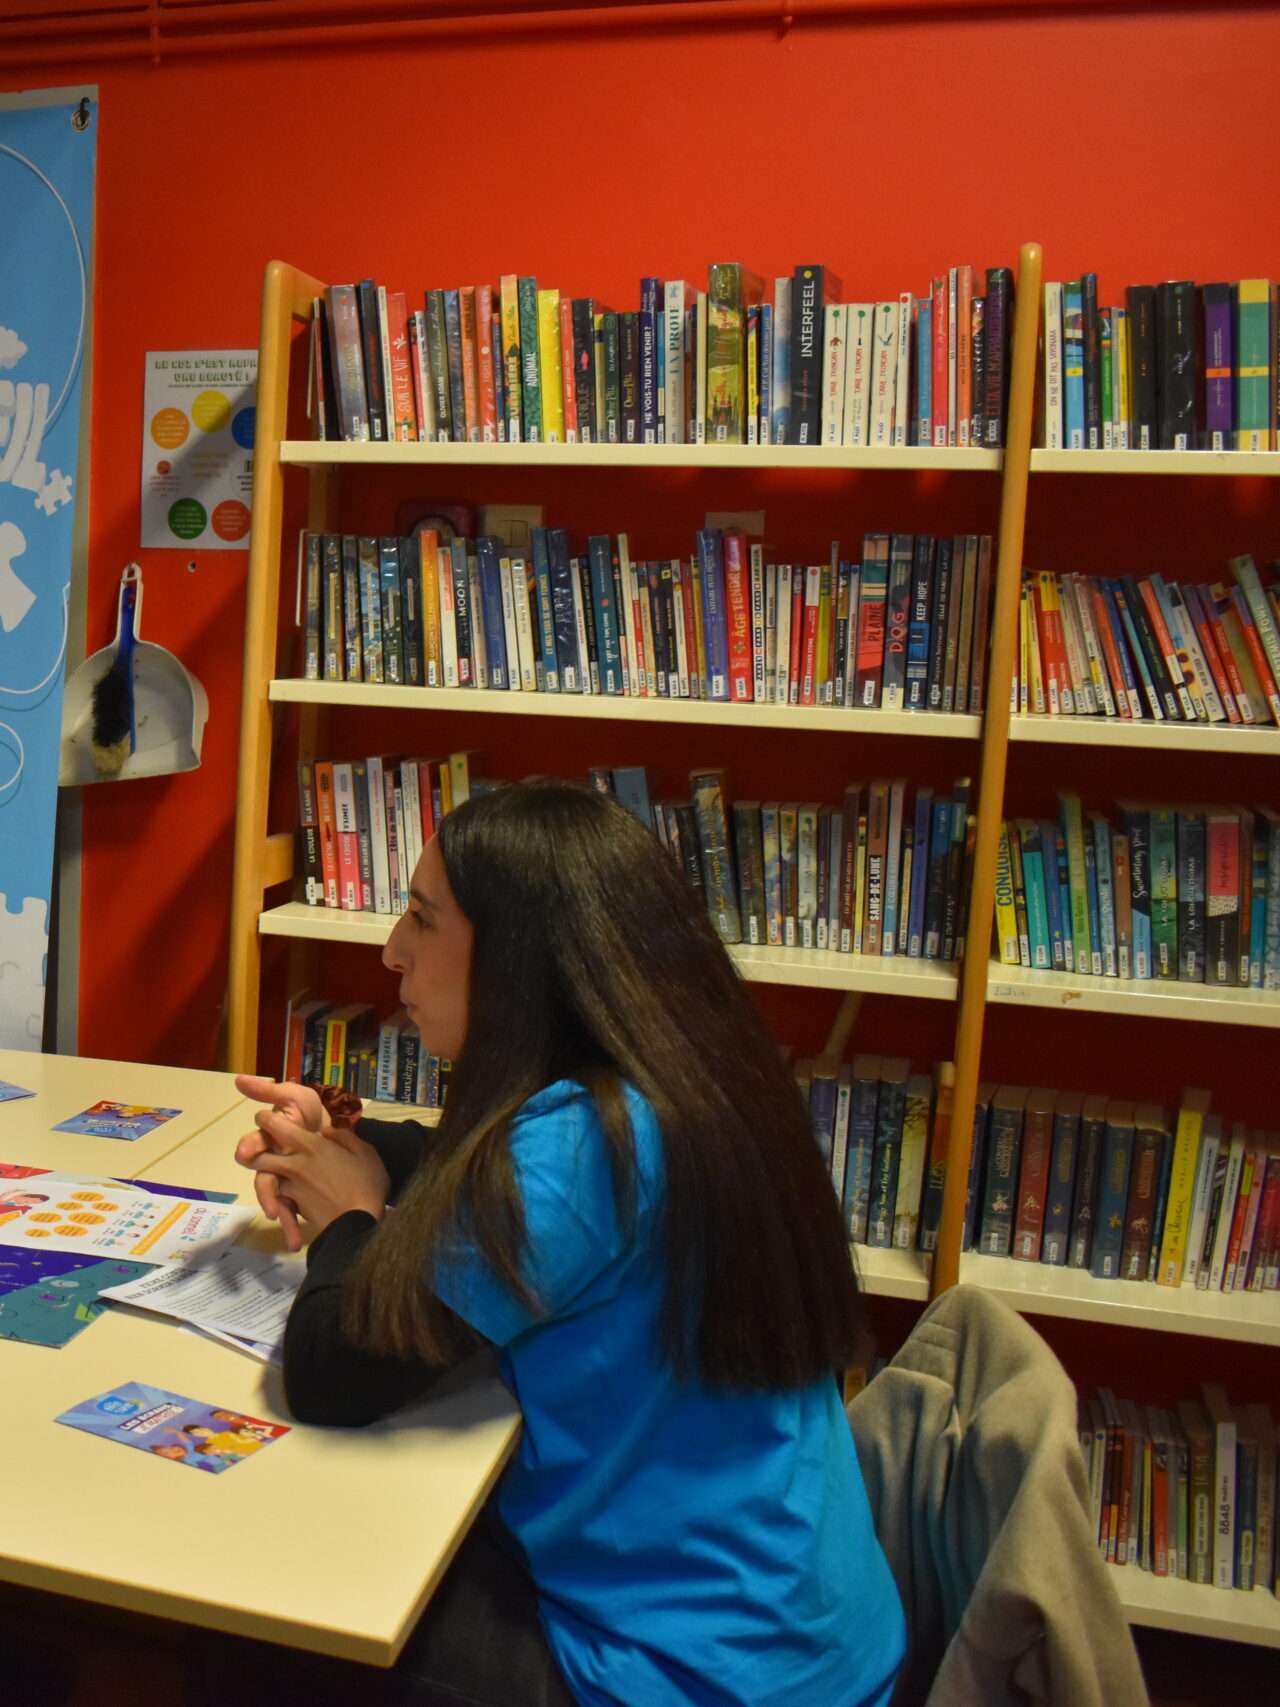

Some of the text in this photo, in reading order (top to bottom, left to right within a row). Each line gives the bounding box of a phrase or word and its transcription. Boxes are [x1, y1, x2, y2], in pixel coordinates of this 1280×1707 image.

[801, 281, 814, 357] INTERFEEL
[395, 375, 408, 388] LE
[396, 392, 410, 412] SUR
[644, 411, 652, 423] NE
[457, 580, 466, 616] MOON
[915, 581, 927, 621] KEEP HOPE
[1218, 1504, 1230, 1535] 8848
